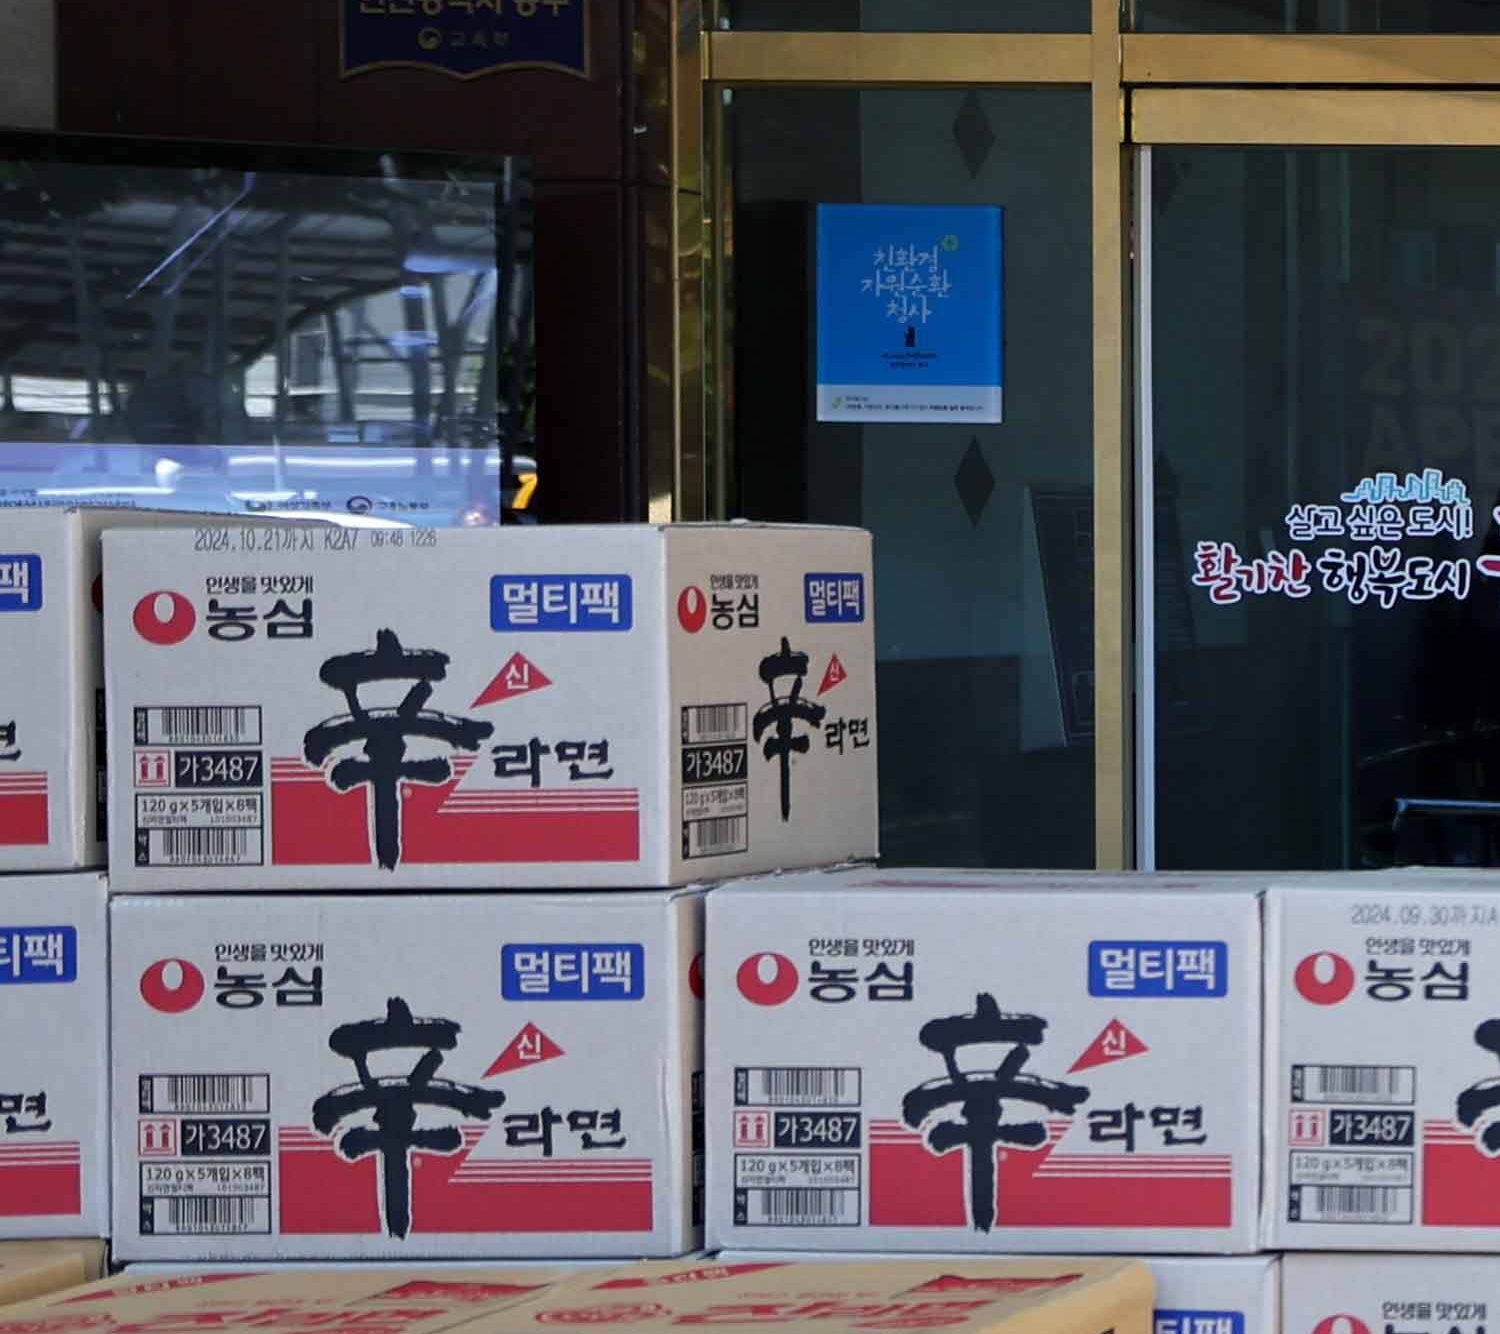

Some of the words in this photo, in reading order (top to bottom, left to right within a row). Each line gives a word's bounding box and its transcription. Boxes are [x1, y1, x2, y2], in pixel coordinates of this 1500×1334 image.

[1286, 504, 1344, 540] 살고
[1348, 504, 1406, 541] 싶은
[1407, 505, 1473, 540] 도시!
[205, 576, 257, 594] 인생을
[262, 576, 314, 594] 맛있게
[1193, 541, 1311, 605] 활기찬
[1318, 546, 1471, 609] 행복도시
[205, 598, 314, 640] 농심
[501, 580, 621, 626] 멀티팩
[505, 663, 530, 690] 신
[305, 629, 494, 871] 辛
[492, 737, 614, 787] 라면
[178, 755, 258, 785] 가3487
[141, 798, 166, 813] 120
